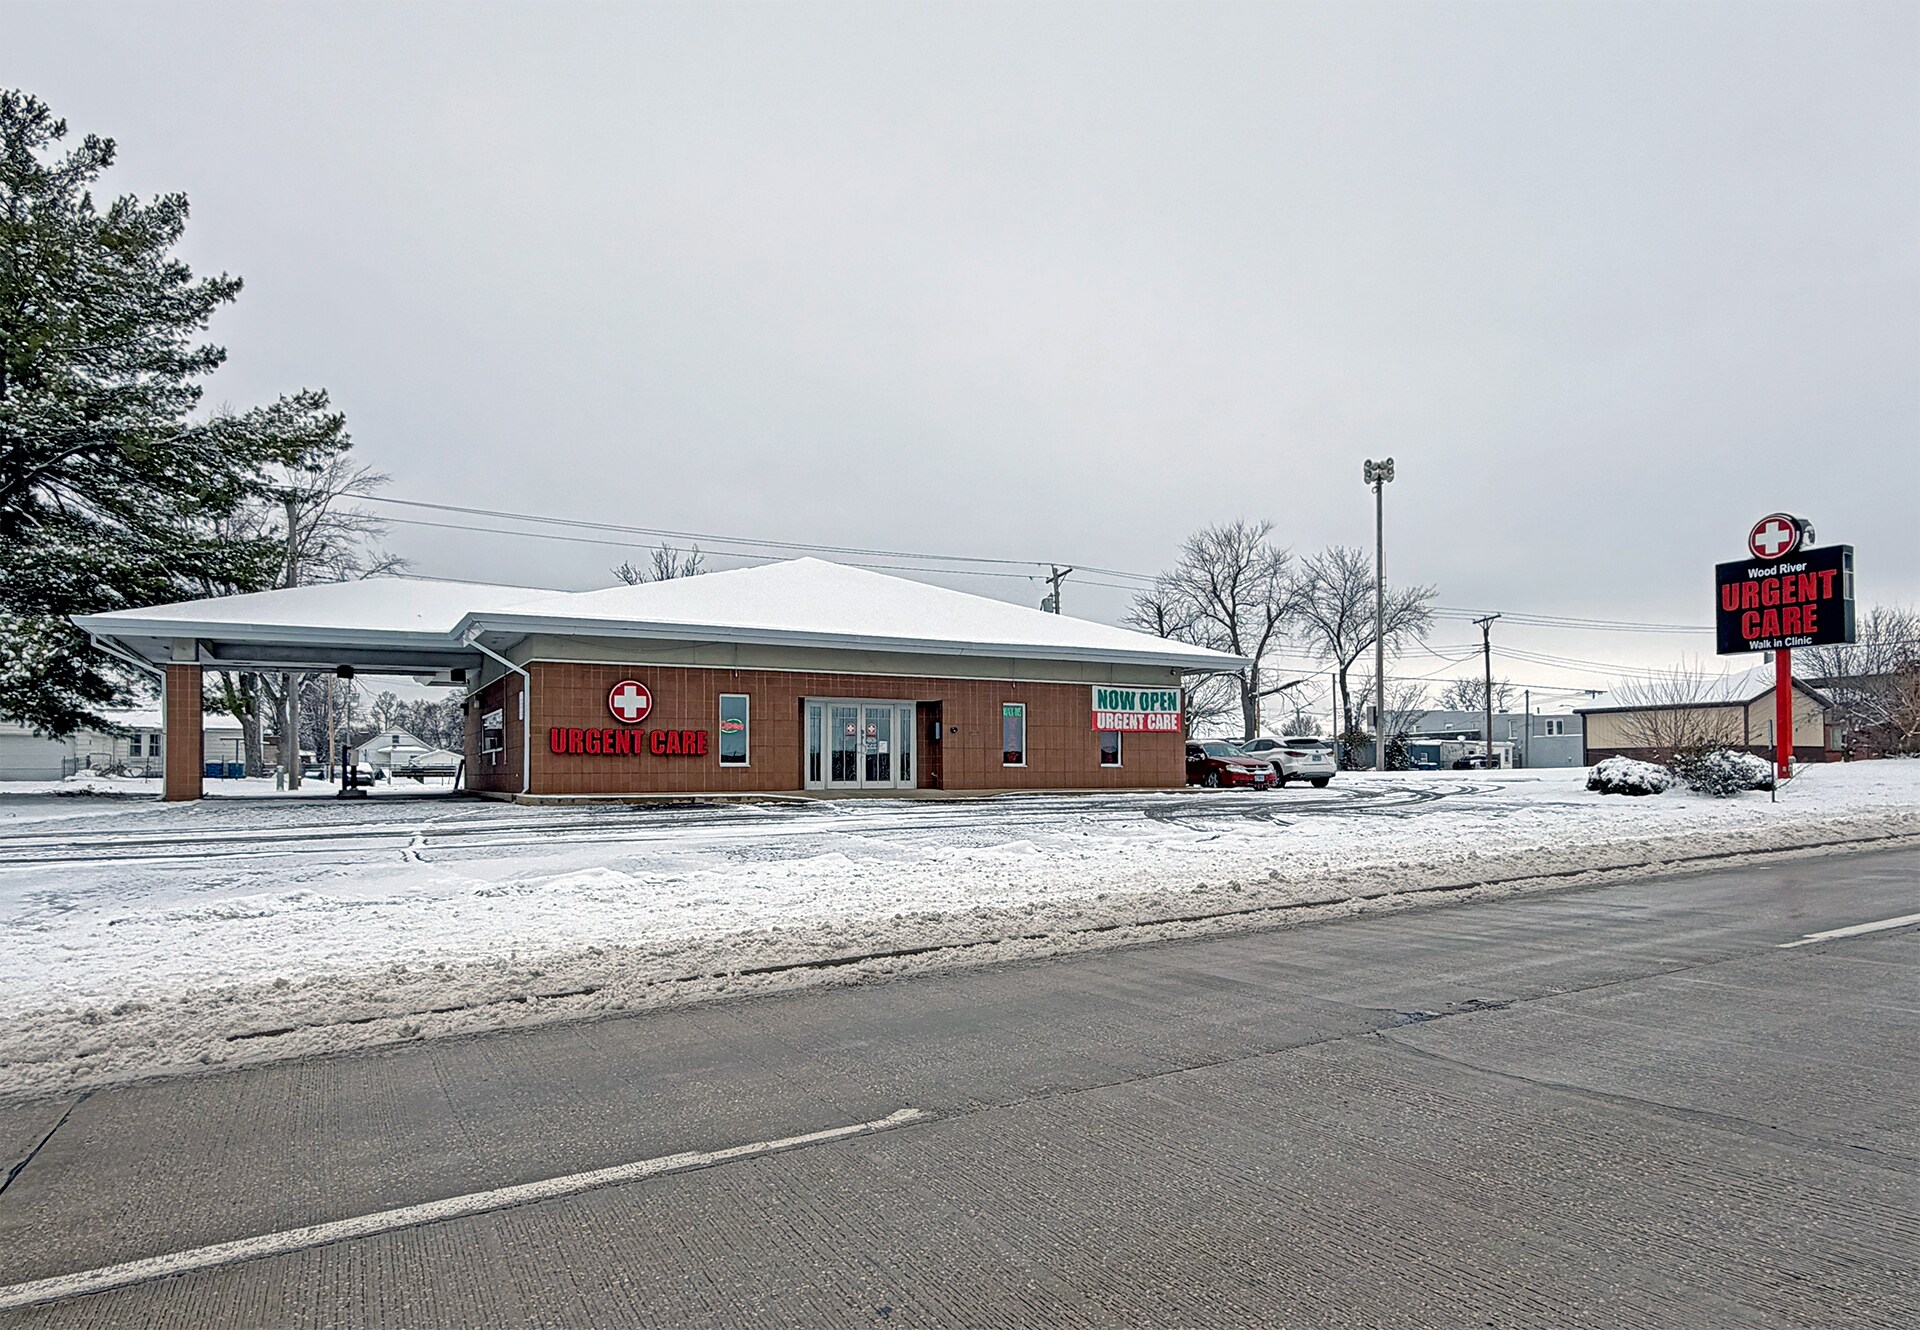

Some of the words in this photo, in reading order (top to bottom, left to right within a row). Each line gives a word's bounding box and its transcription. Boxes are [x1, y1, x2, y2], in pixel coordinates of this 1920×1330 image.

[1748, 565, 1777, 578] Wood
[1780, 563, 1807, 574] River
[1722, 569, 1837, 611] URGENT
[1742, 604, 1818, 639] CARE
[1749, 640, 1771, 650] Walk
[1773, 638, 1782, 648] in
[1785, 635, 1812, 646] Clinic
[1097, 689, 1136, 710] NOW
[1139, 691, 1177, 711] OPEN
[1096, 713, 1145, 729] URGENT
[1147, 714, 1177, 730] CARE
[551, 728, 645, 754] URGENT
[650, 729, 708, 755] CARE
